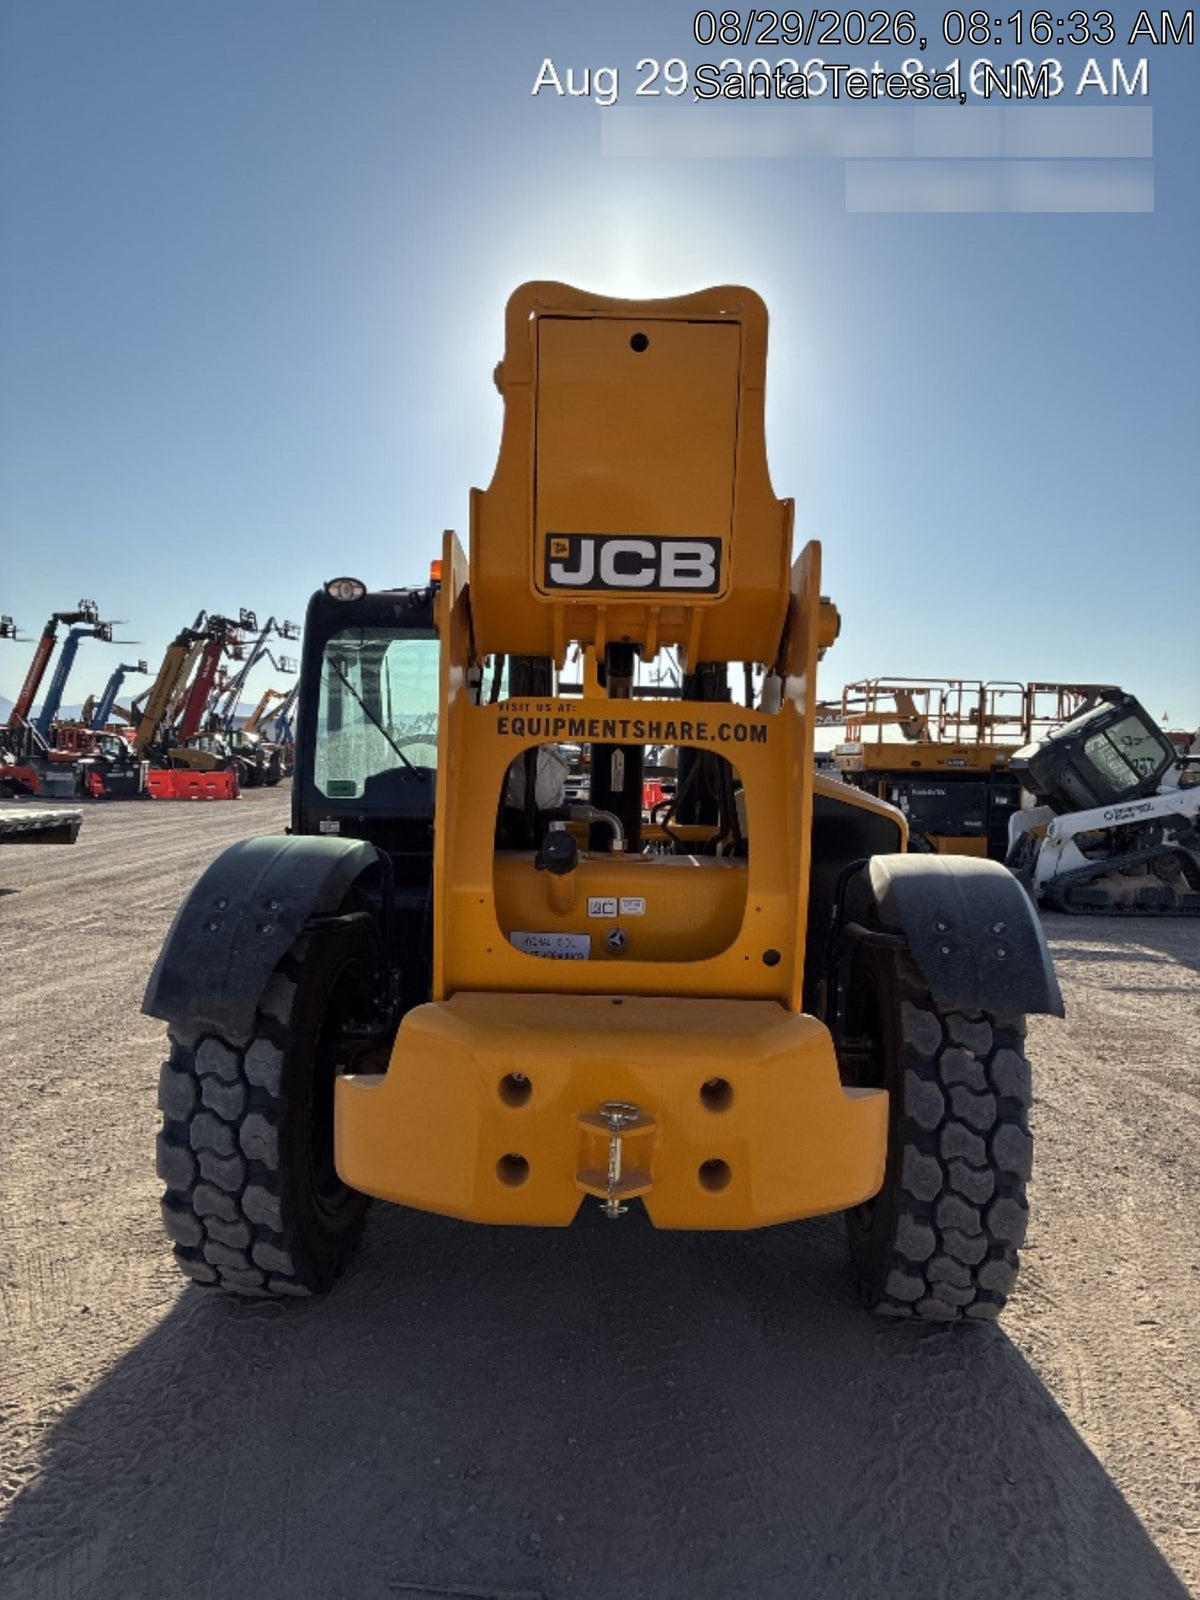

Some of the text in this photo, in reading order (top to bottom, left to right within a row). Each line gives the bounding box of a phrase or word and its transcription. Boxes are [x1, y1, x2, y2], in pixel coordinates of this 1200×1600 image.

[550, 539, 716, 588] JCB
[498, 702, 530, 711] VISIT
[536, 703, 552, 712] US
[497, 716, 768, 744] EQUIPMENTSHARE.COM
[815, 714, 848, 726] CAS
